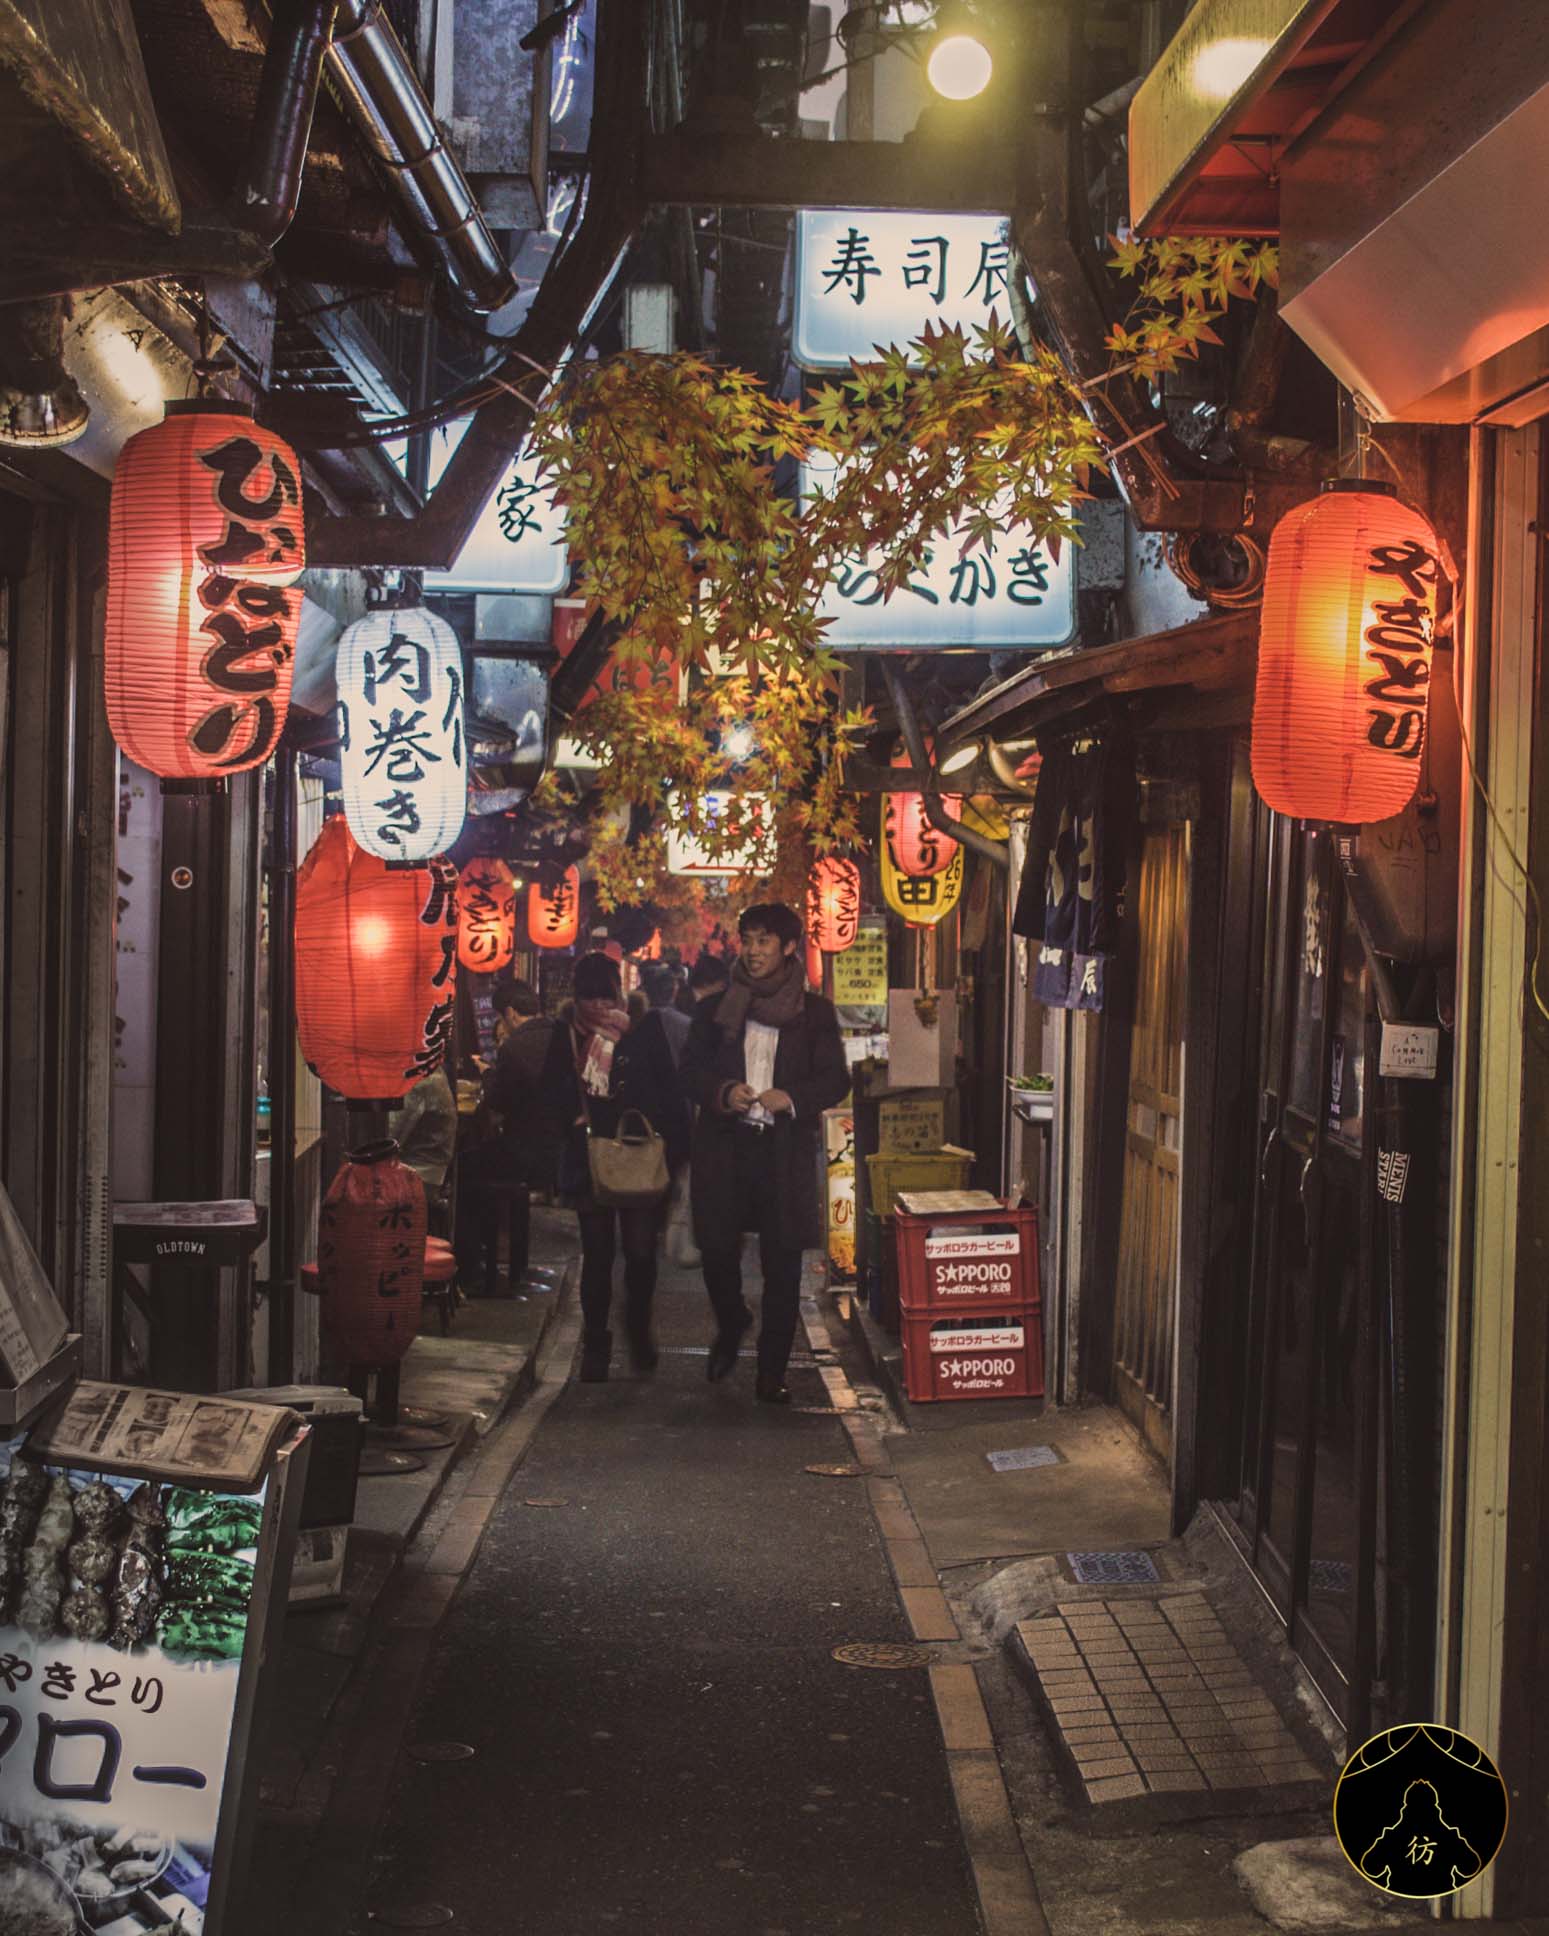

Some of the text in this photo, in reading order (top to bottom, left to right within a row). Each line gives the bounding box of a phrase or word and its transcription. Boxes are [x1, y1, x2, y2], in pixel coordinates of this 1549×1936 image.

[822, 228, 1010, 306] 寿司辰
[1364, 540, 1440, 759] やきとり
[363, 633, 442, 845] 肉巻き
[156, 1241, 206, 1256] OLDTOWN
[926, 1241, 1015, 1255] サッポロラガービール
[930, 1333, 1019, 1347] サッポロラガービール
